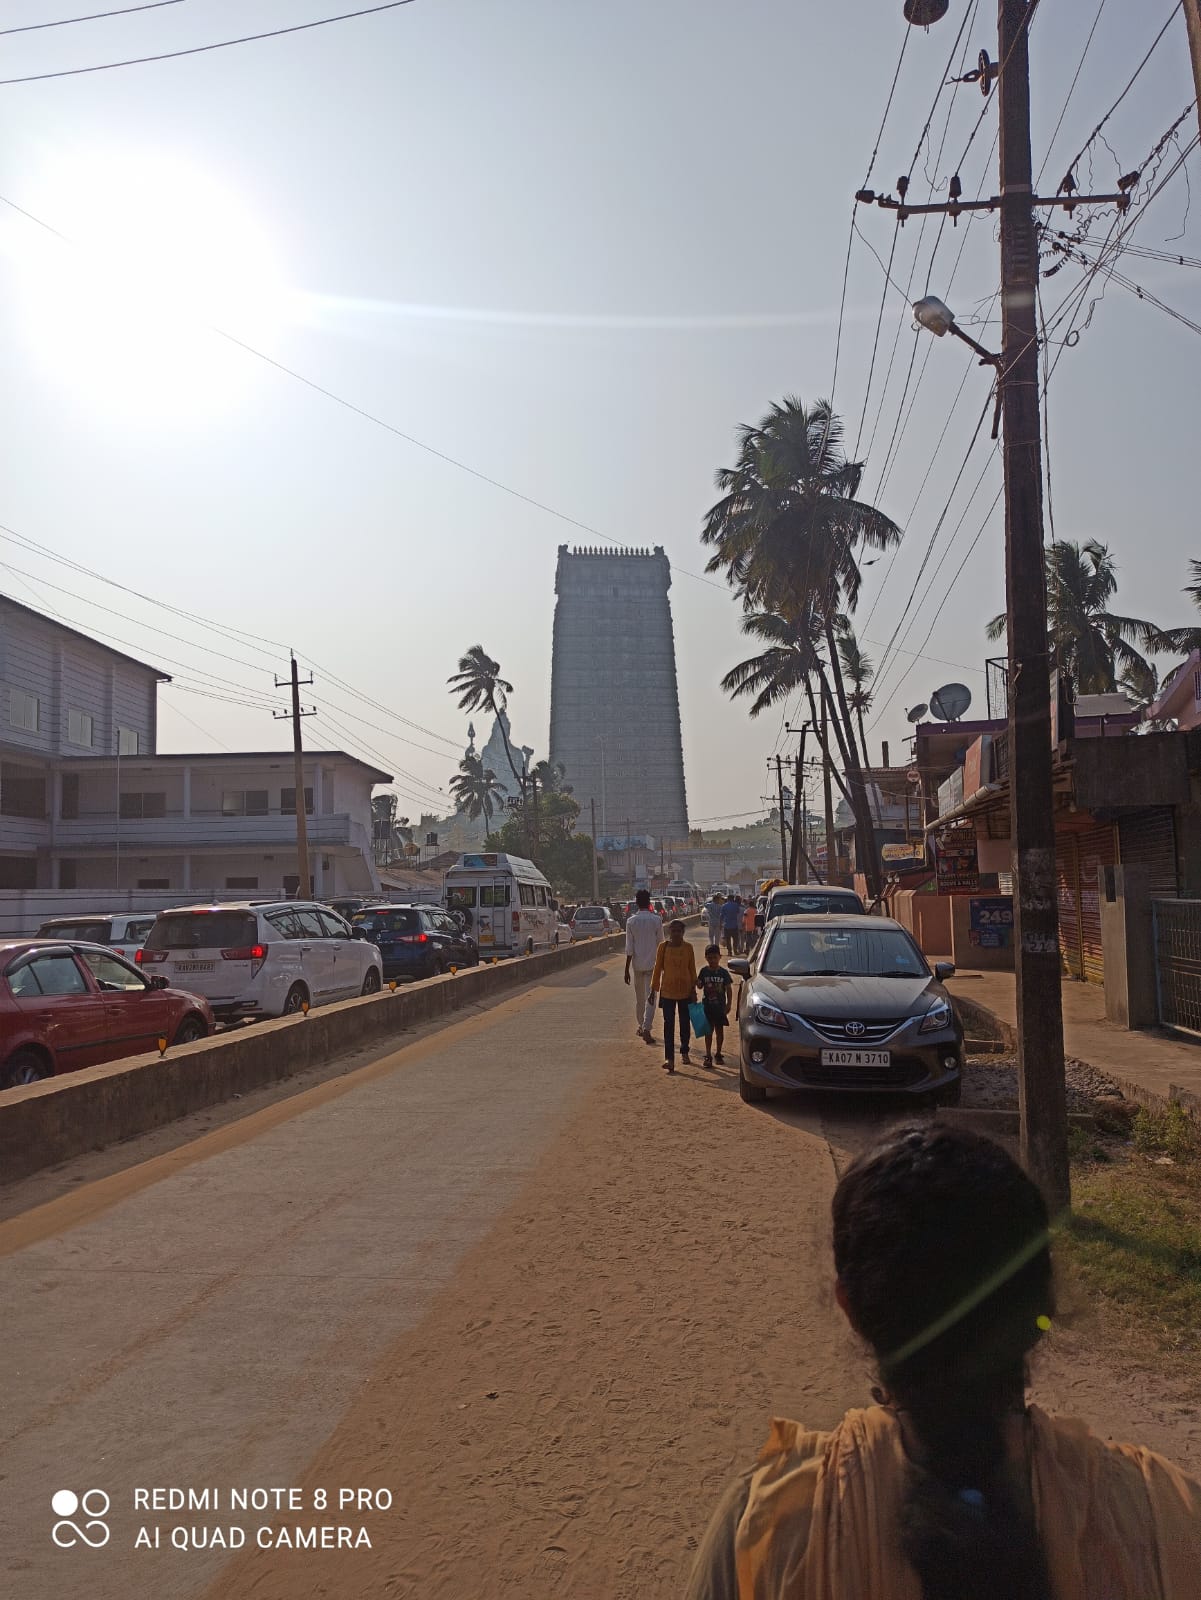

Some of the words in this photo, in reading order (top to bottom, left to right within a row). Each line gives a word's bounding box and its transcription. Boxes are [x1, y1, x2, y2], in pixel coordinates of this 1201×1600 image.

[979, 910, 1013, 924] 249
[828, 1052, 853, 1064] KA07
[865, 1053, 889, 1065] 3710
